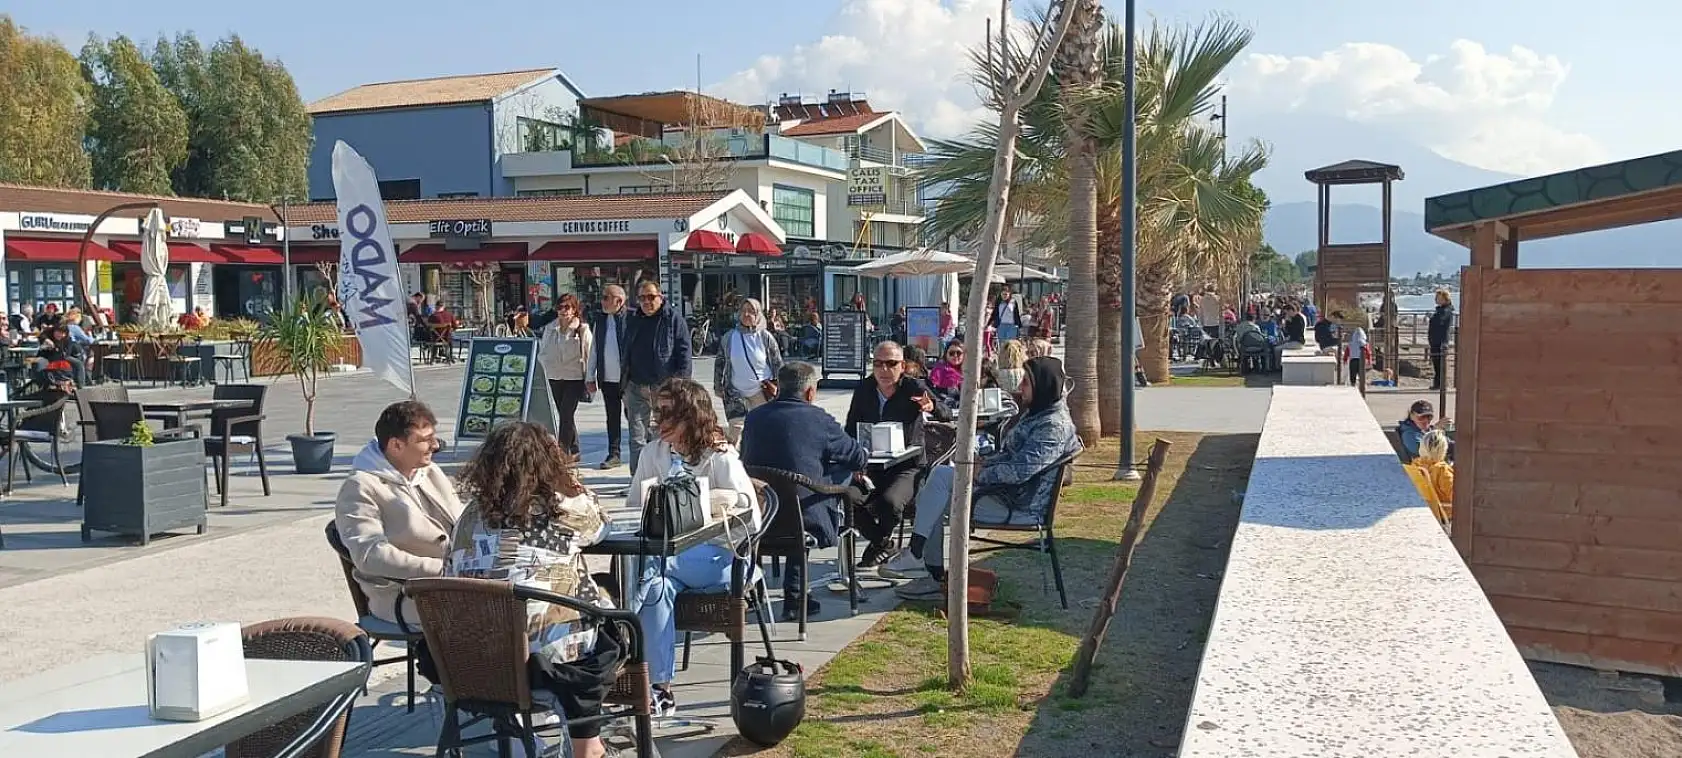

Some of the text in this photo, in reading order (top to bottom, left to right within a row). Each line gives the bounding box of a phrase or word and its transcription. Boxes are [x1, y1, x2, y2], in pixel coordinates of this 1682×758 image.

[853, 177, 879, 185] TAXI
[21, 216, 53, 229] GURU
[430, 217, 488, 236] Elit Optik
[563, 220, 630, 233] CERVOS COFFEE
[311, 224, 340, 240] Sho
[346, 204, 397, 328] MADO
